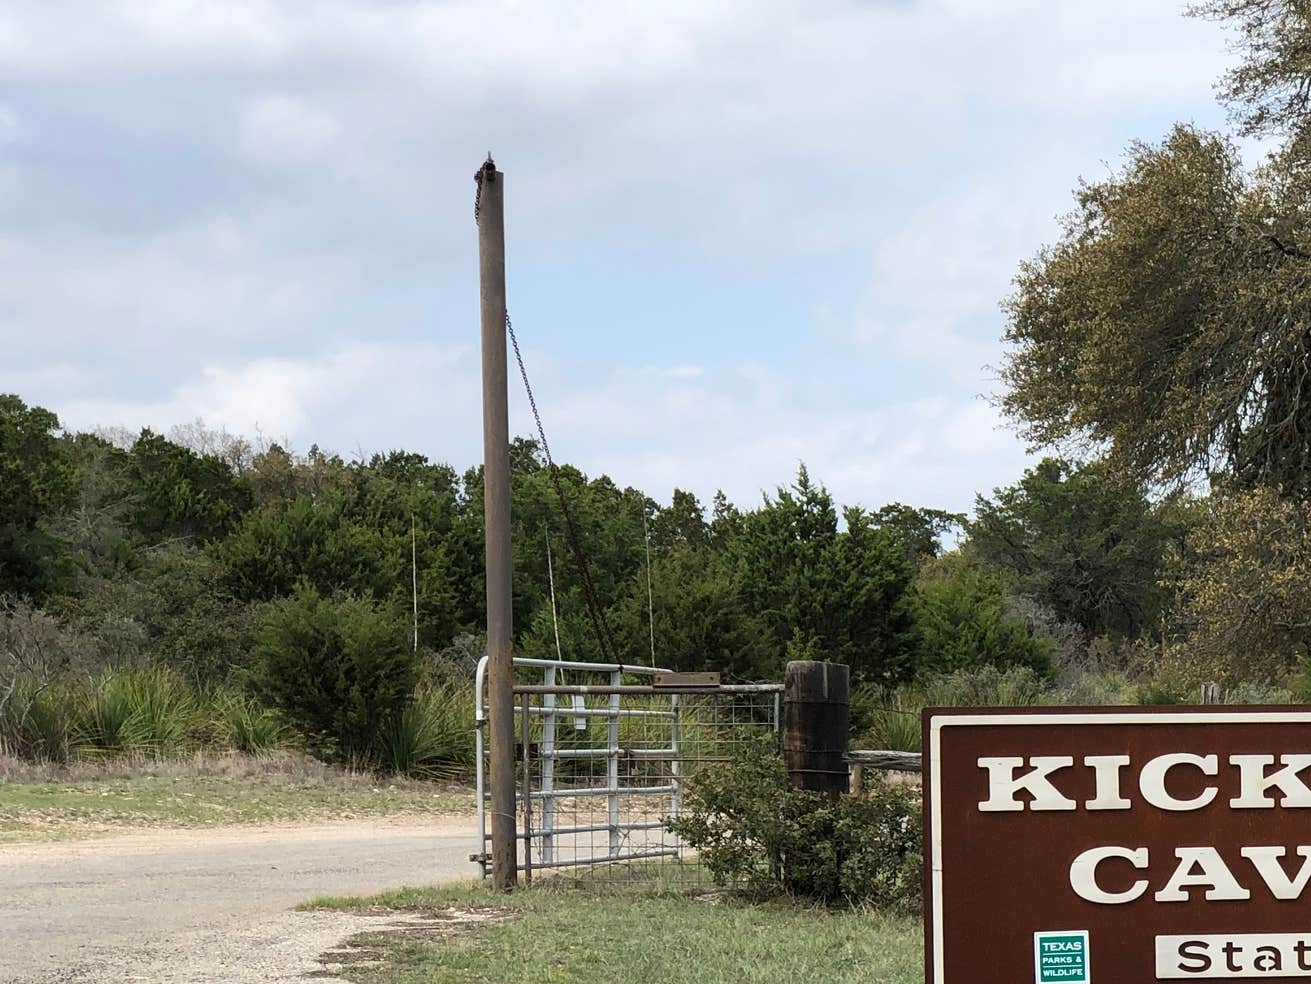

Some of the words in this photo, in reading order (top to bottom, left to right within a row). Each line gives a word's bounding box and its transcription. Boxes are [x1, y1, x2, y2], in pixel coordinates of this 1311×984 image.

[1042, 941, 1082, 952] TEXAS
[1042, 956, 1073, 964] PARKS
[1043, 968, 1083, 977] WILDLIFE
